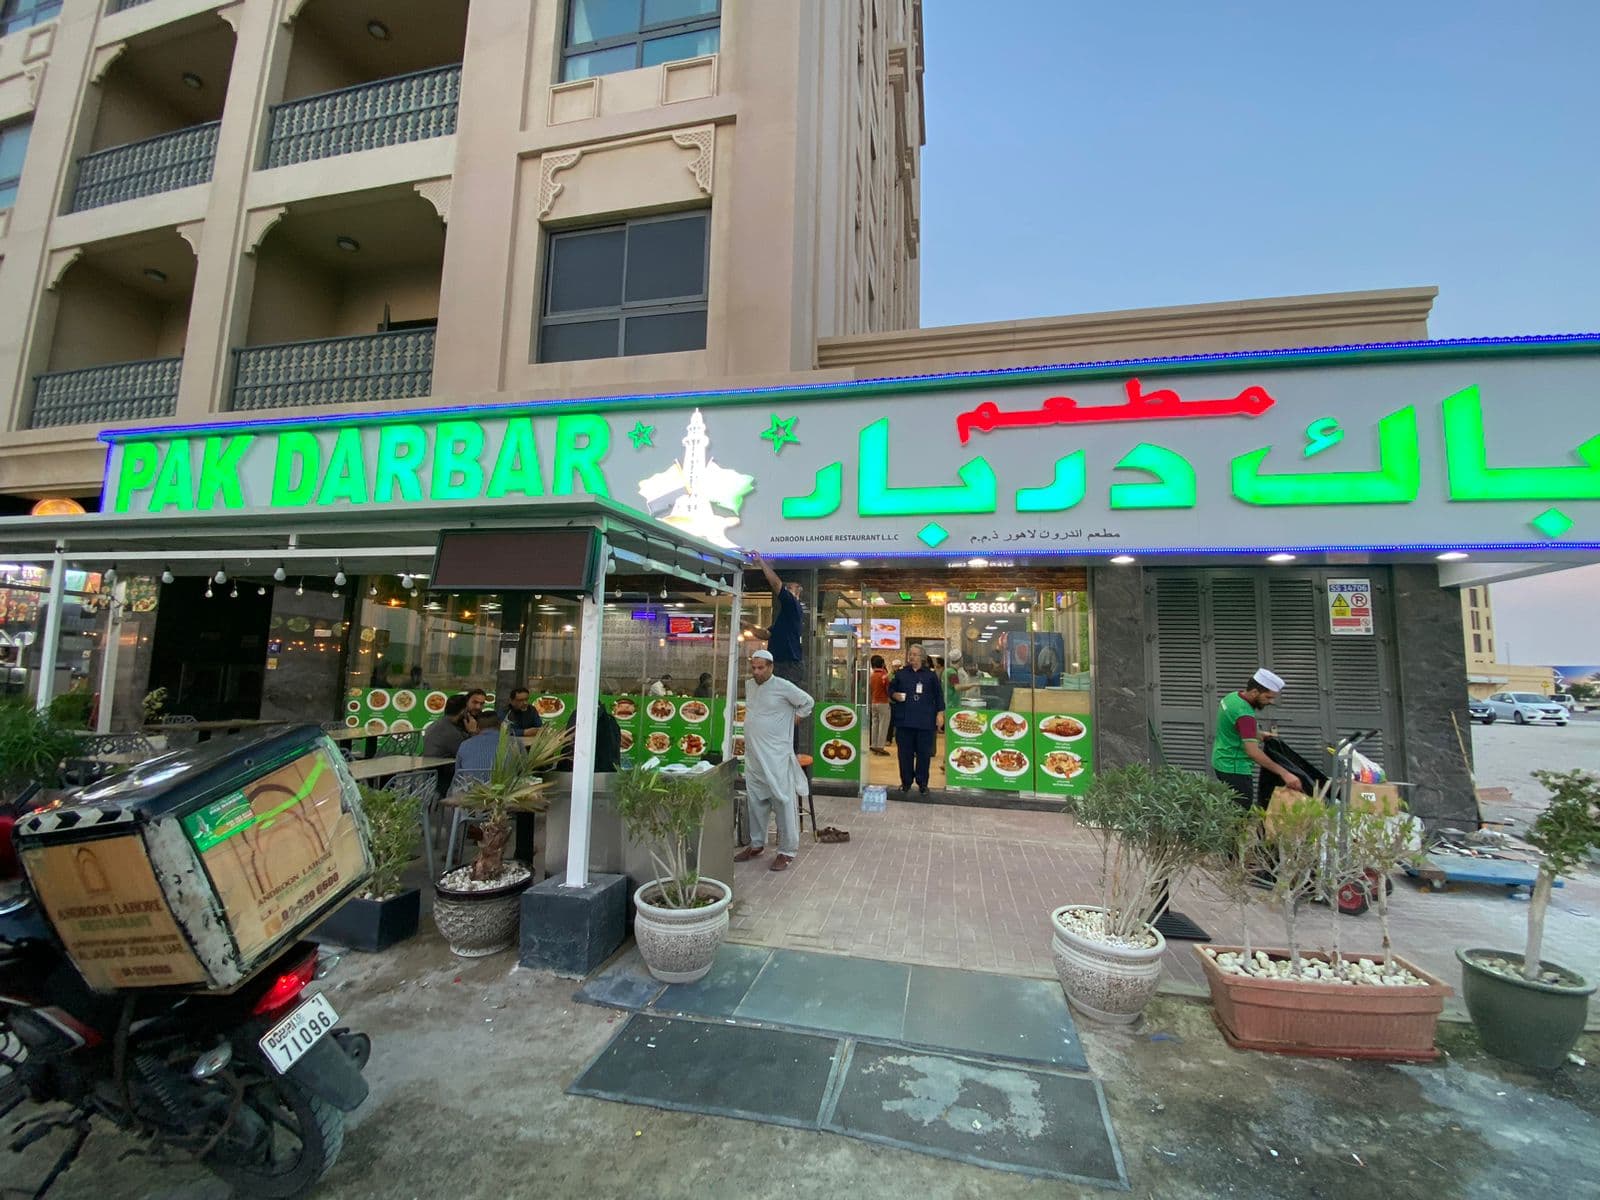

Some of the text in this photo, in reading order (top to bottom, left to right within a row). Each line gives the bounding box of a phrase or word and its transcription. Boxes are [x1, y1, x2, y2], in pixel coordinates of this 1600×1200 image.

[957, 377, 1276, 447] مطعم
[114, 413, 611, 514] PAK DARBAR
[781, 416, 1197, 549] دربار
[770, 535, 804, 543] ANDROON
[1003, 529, 1036, 542] لاهور
[1087, 528, 1121, 541] مطعم
[279, 1011, 331, 1062] 71096
